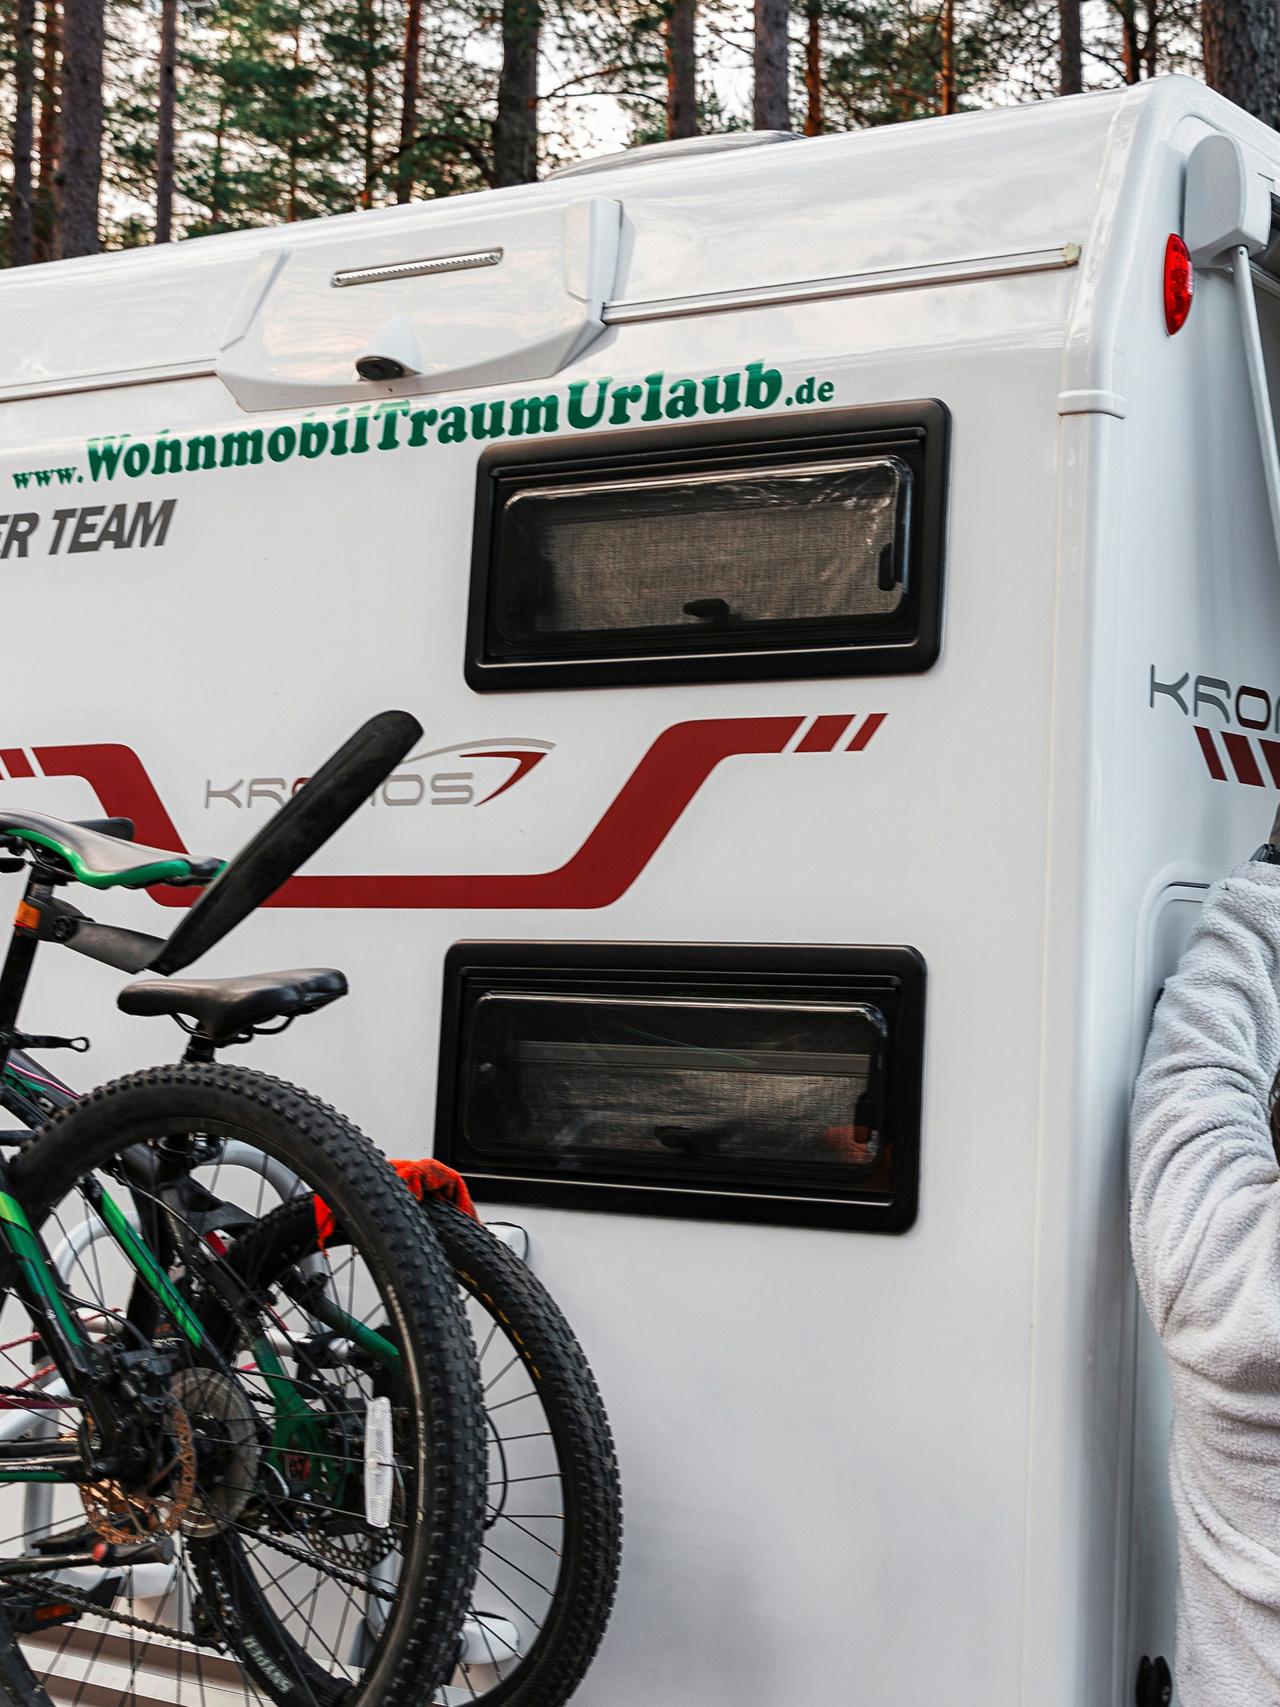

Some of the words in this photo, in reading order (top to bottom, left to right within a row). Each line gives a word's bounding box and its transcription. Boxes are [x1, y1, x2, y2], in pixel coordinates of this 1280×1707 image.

[13, 359, 834, 490] www.WohnmobilTraumUrlaub.de
[47, 498, 178, 555] TEAM
[204, 772, 475, 809] KROS
